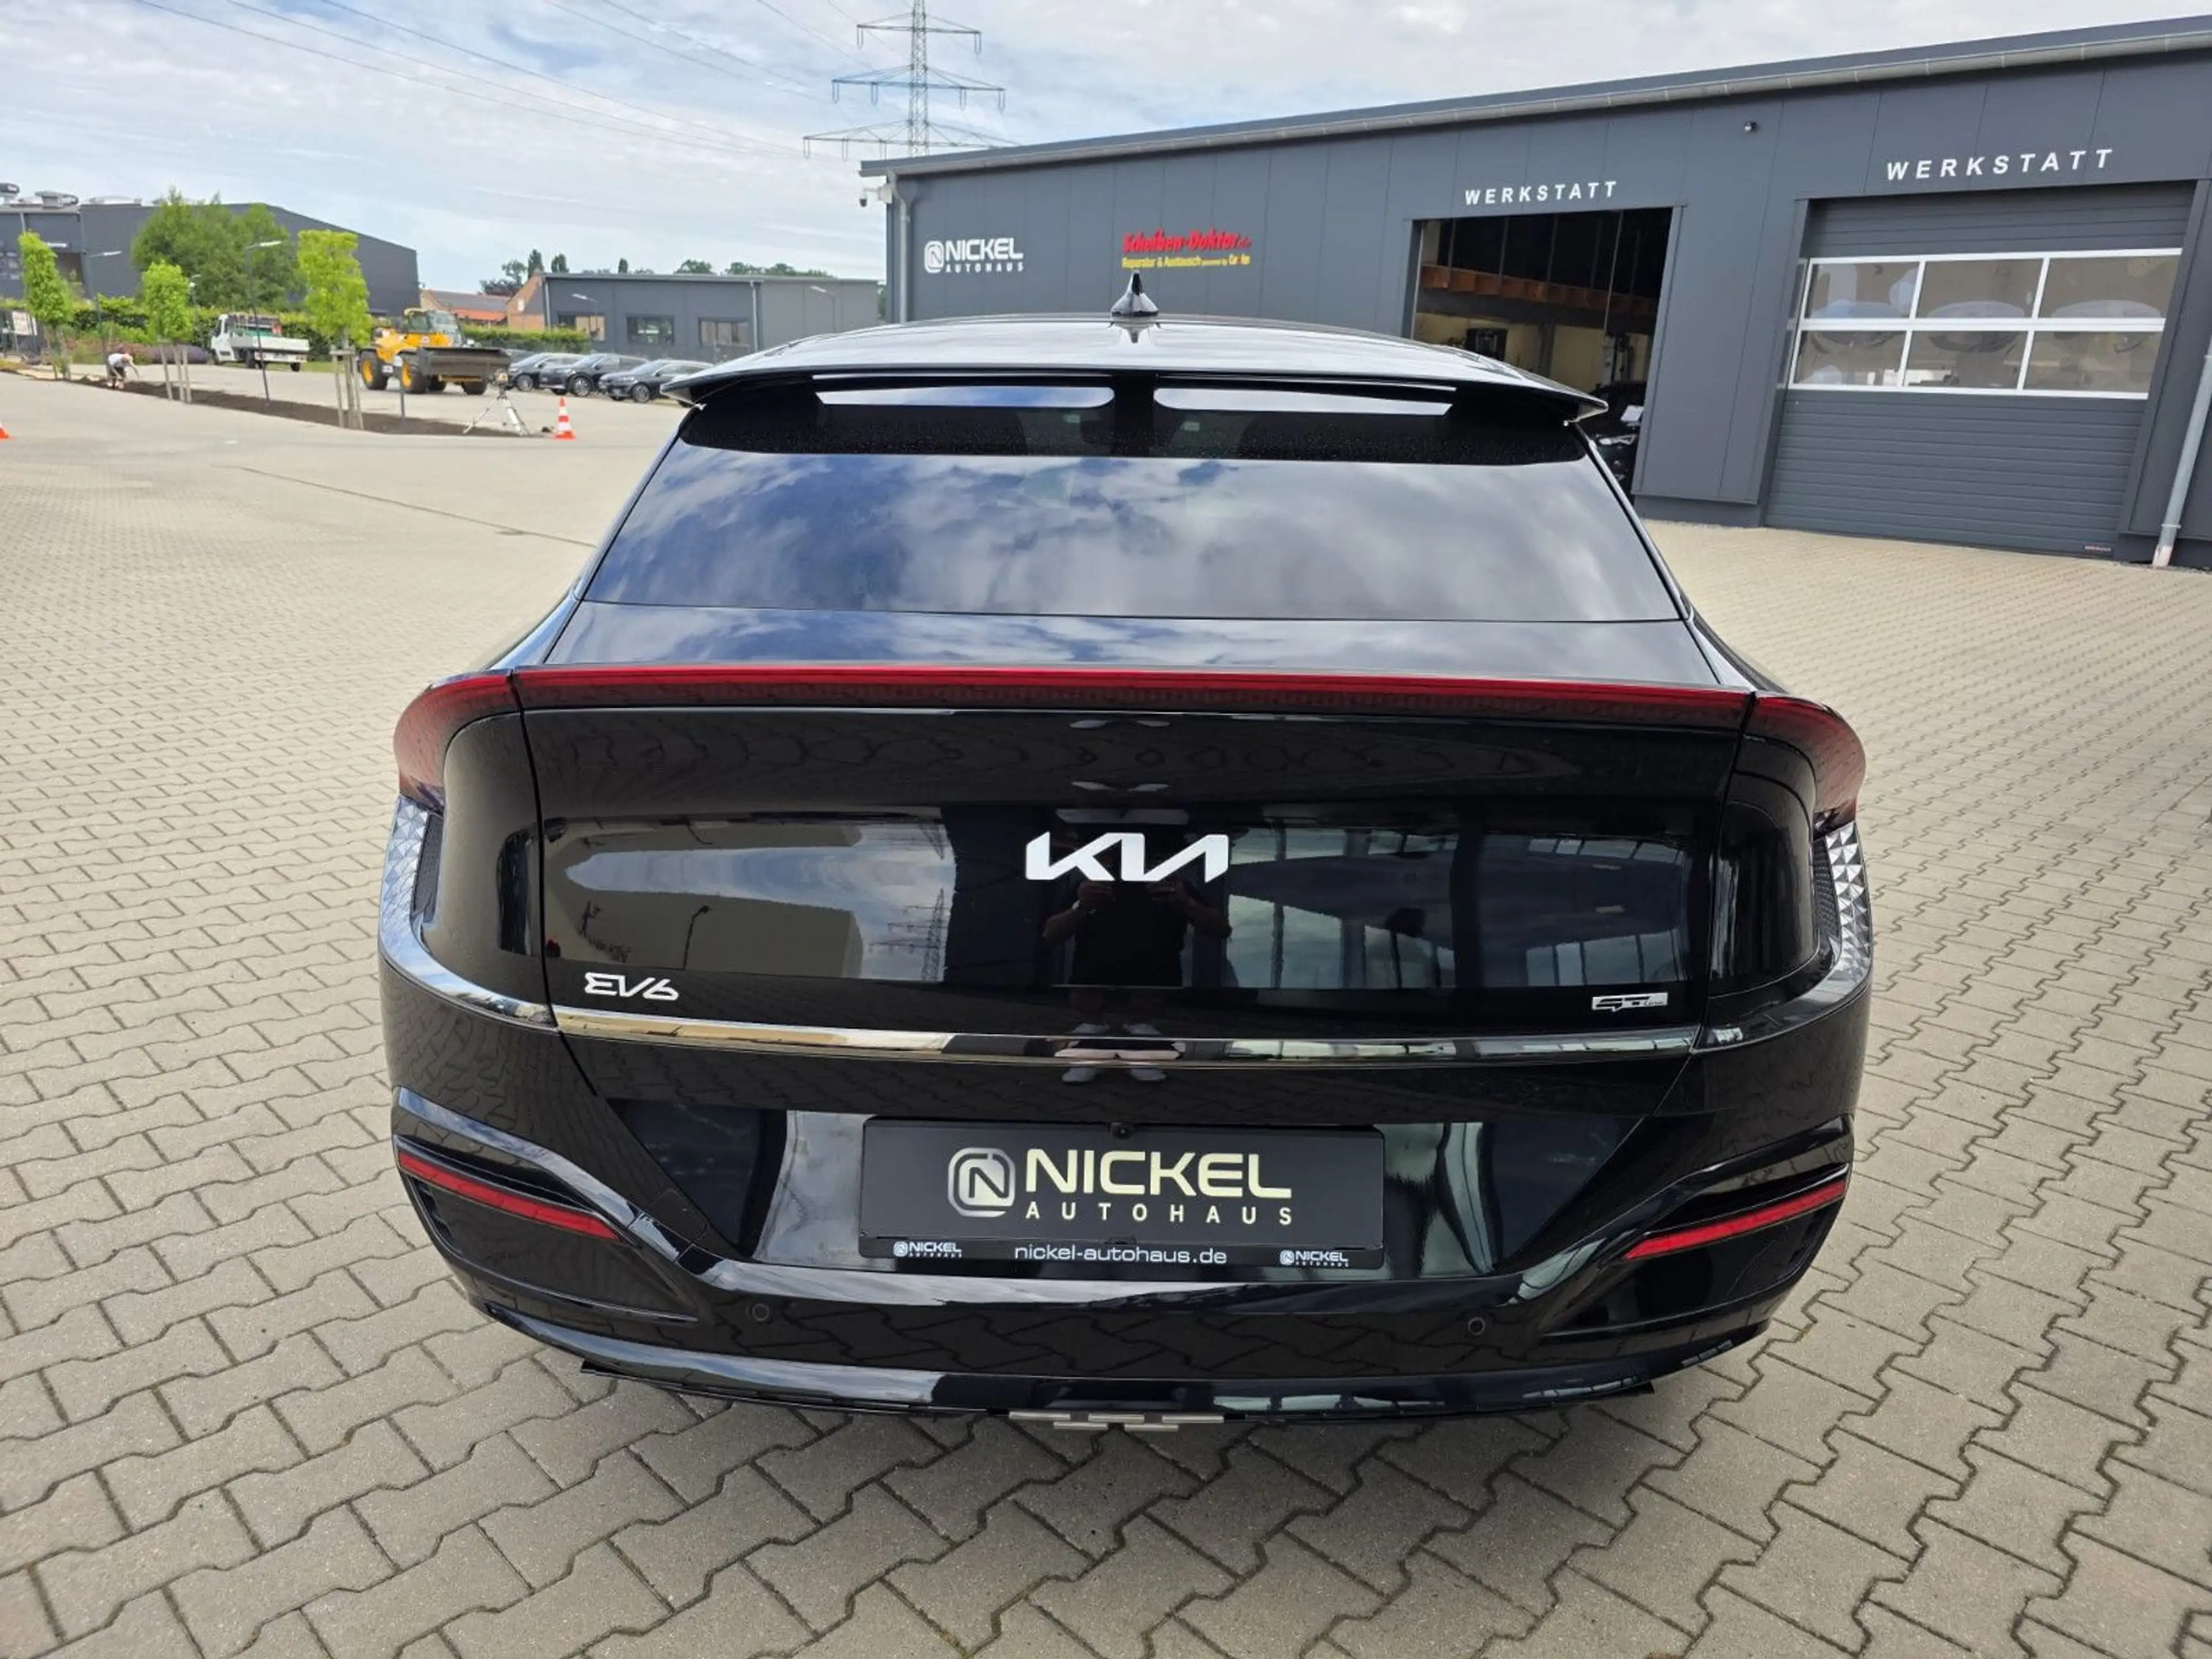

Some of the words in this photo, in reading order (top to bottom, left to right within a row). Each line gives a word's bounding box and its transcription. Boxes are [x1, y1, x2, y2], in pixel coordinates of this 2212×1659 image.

[1887, 149, 2112, 180] WERKSTATT
[1465, 181, 1616, 206] WERKSTATT
[945, 238, 1024, 261] NICKEL
[945, 262, 1024, 273] AUTOHAUS
[1026, 831, 1229, 882] KIA
[585, 972, 679, 1001] EV6
[1026, 1149, 1291, 1198] NICKEL
[1026, 1201, 1291, 1225] AUTOHAUS
[909, 1241, 962, 1252] NICKEL
[1014, 1244, 1227, 1263] nickel-autohaus.de
[1295, 1251, 1349, 1262] NICKEL
